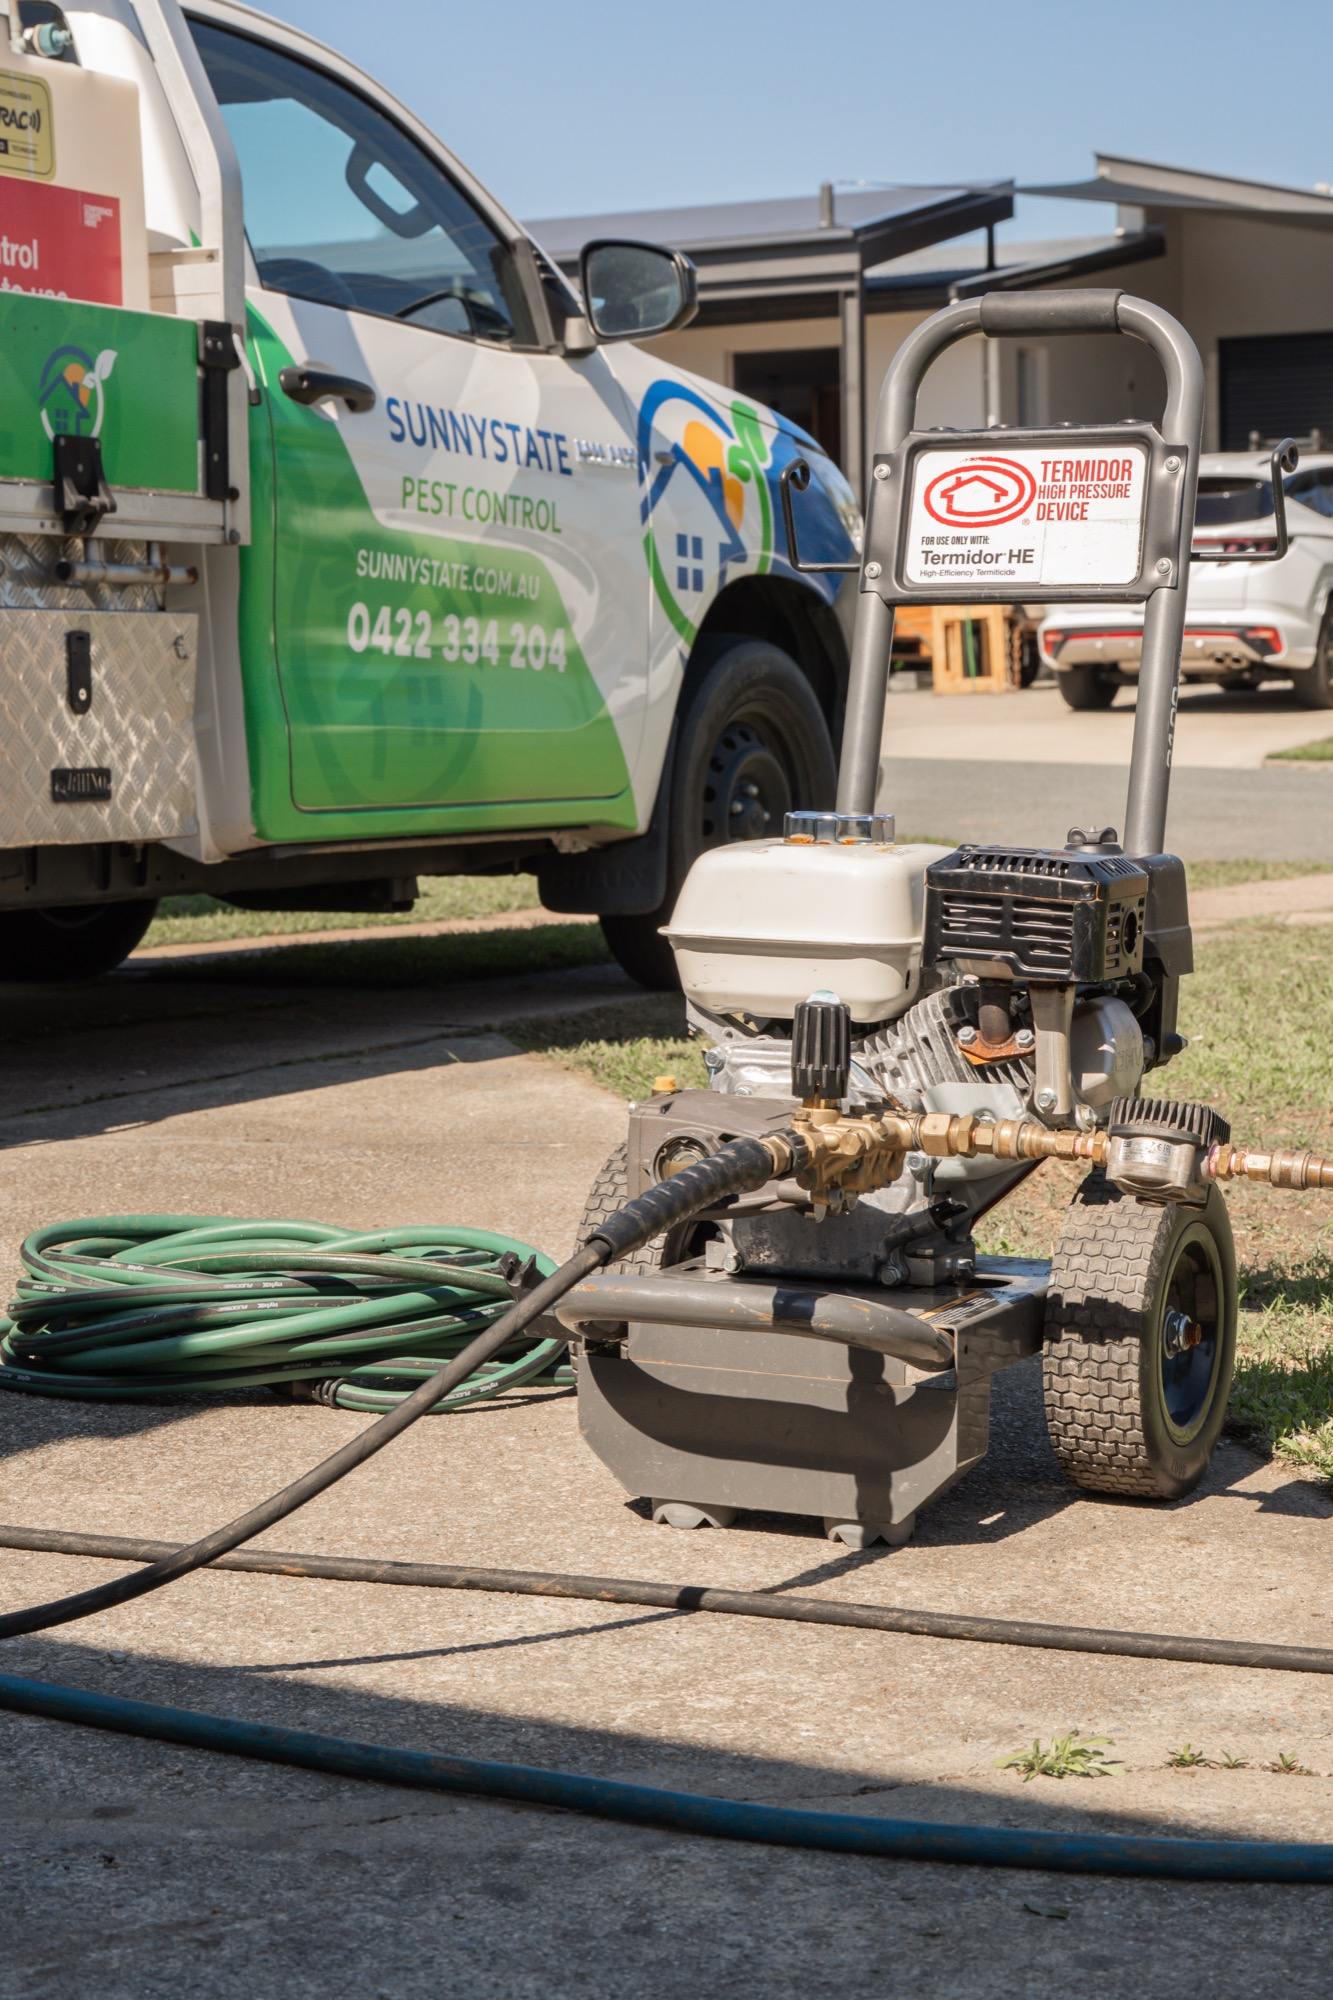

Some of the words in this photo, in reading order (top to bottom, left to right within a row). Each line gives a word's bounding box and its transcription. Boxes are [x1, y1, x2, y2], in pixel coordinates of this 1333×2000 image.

[0, 235, 39, 270] trol
[386, 397, 573, 476] SUNNYSTATE
[1040, 459, 1133, 482] TERMIDOR
[1037, 484, 1066, 500] HIGH
[1069, 483, 1132, 499] PRESSURE
[402, 475, 458, 517] PEST
[462, 487, 562, 533] CONTROL
[1036, 502, 1090, 521] DEVICE
[920, 536, 935, 546] FOR
[936, 536, 950, 546] USE
[951, 536, 969, 545] ONLY
[970, 535, 990, 545] WITH:
[1007, 549, 1035, 564] HE
[356, 549, 540, 600] SUNNYSTATE.COM.AU
[919, 569, 975, 578] High-Efficiency
[976, 568, 1016, 576] Termiticide
[347, 602, 432, 659] 0422
[442, 614, 500, 667] 334
[510, 622, 568, 673] 204
